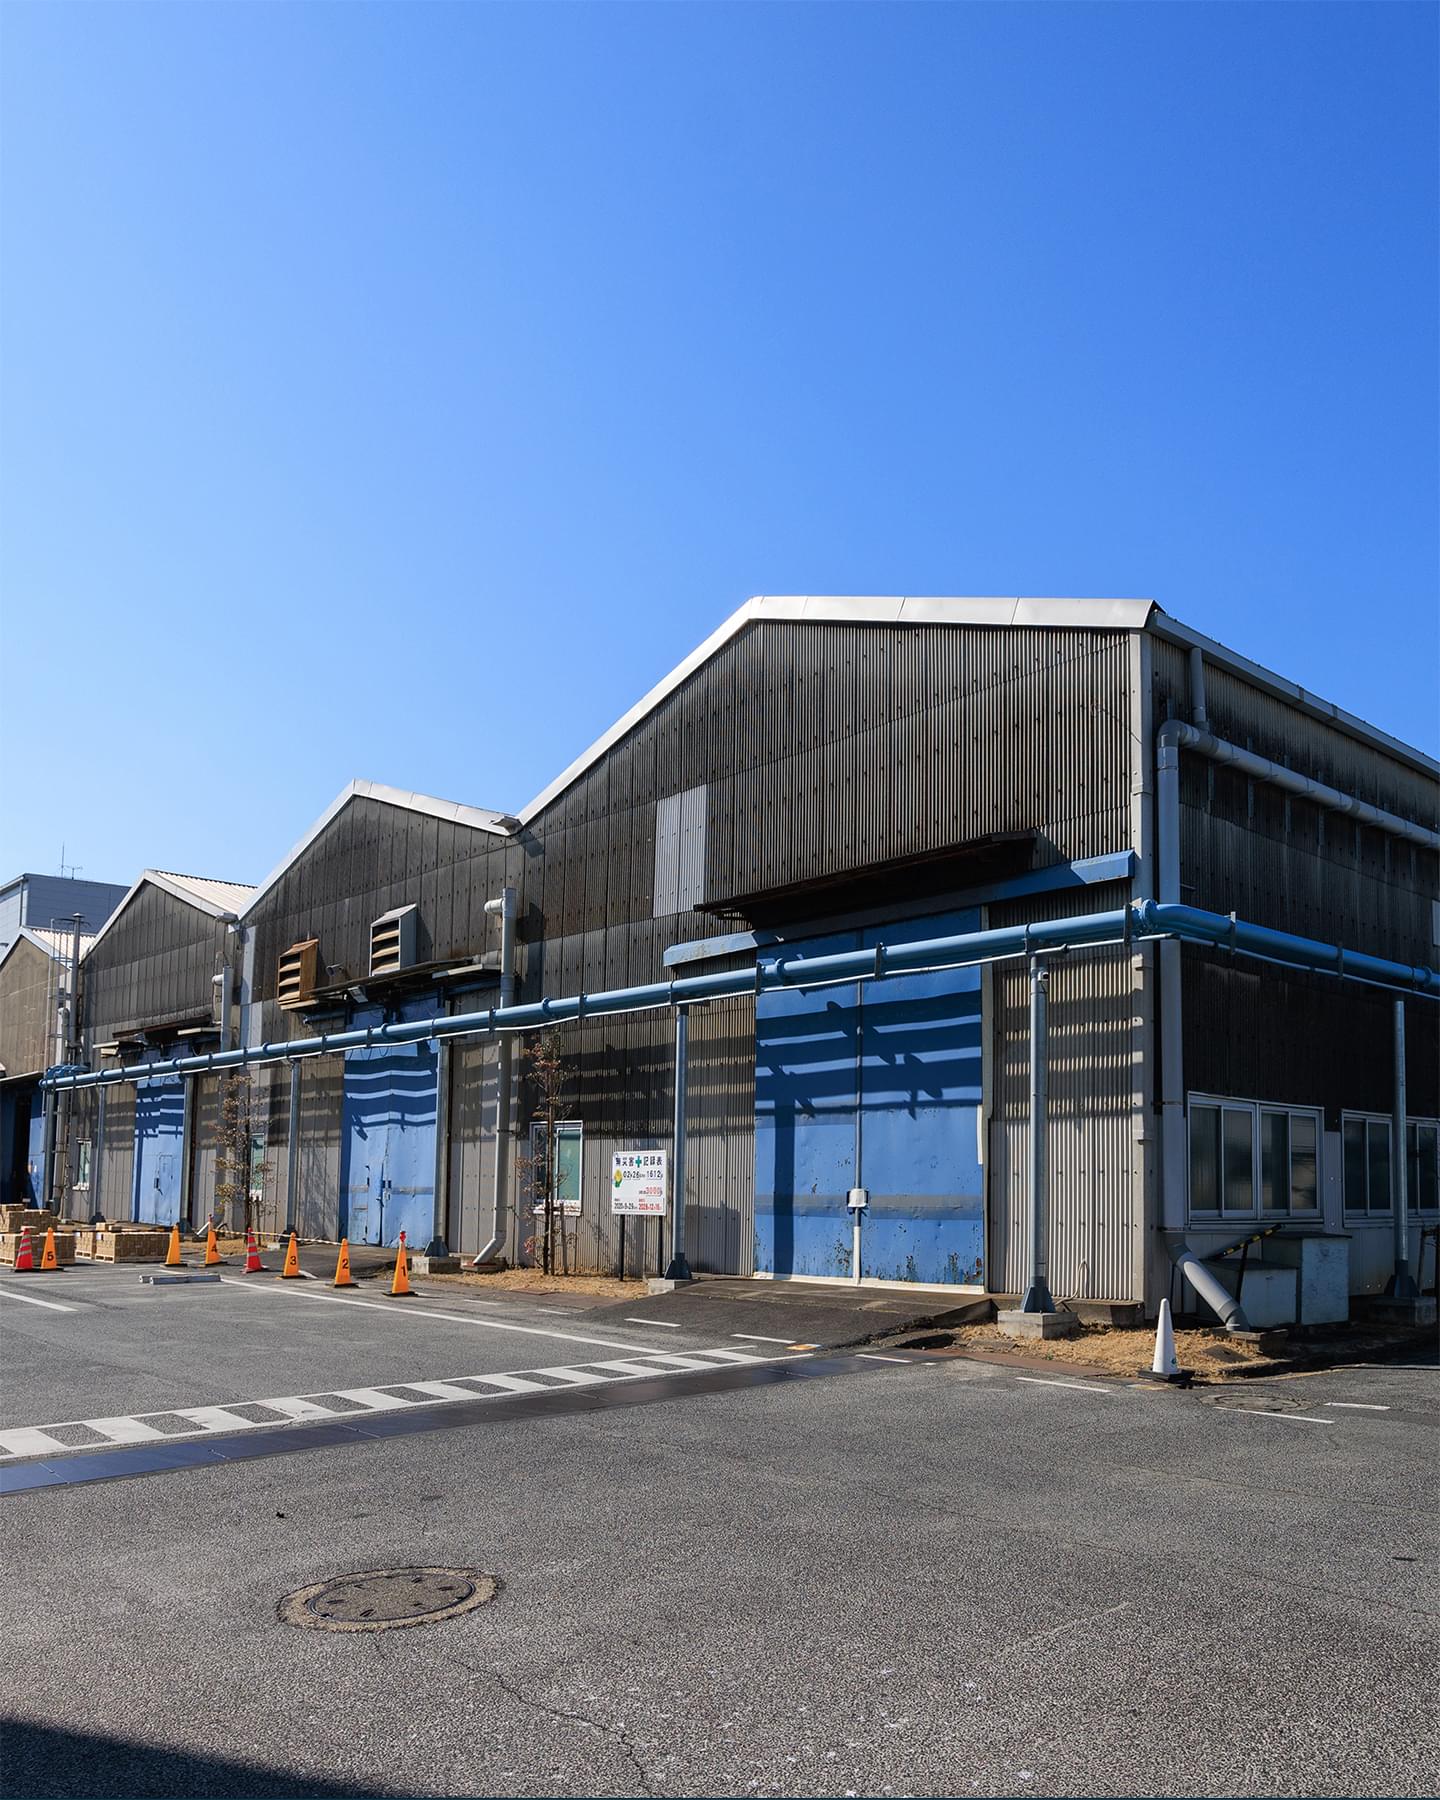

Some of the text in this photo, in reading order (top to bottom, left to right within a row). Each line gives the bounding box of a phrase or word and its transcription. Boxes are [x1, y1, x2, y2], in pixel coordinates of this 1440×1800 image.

[211, 1244, 217, 1253] 4
[47, 1251, 54, 1261] 5
[290, 1255, 297, 1266] 3
[342, 1258, 349, 1269] 2
[401, 1265, 406, 1277] 1
